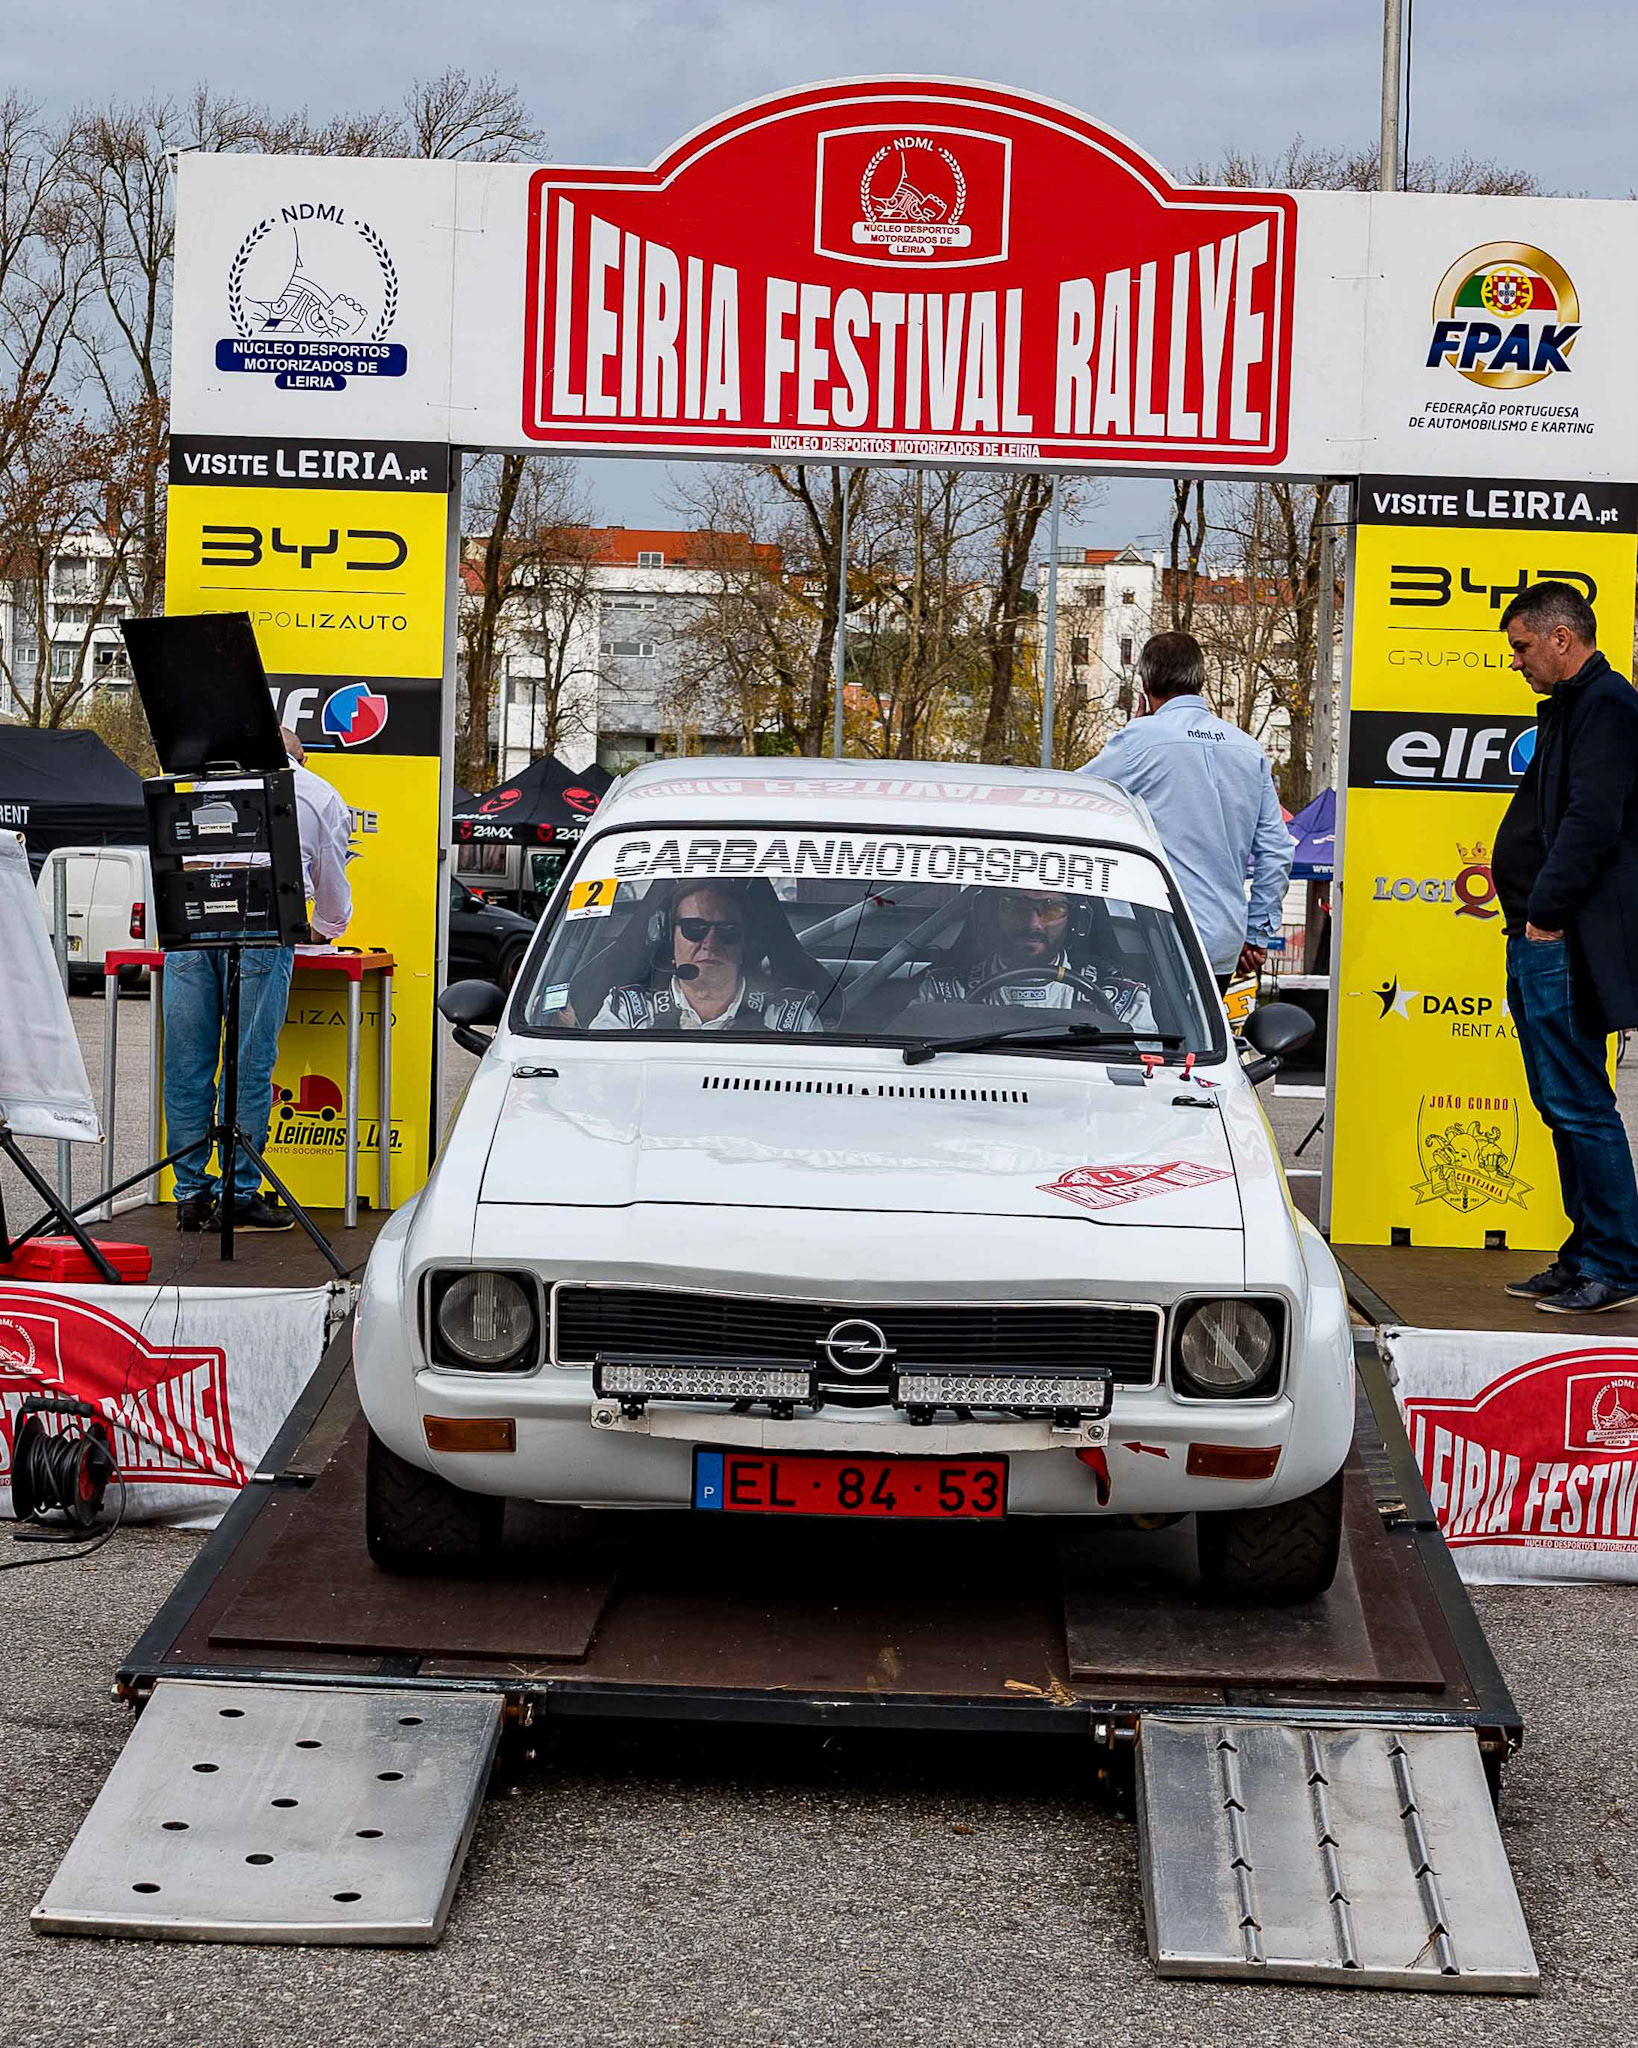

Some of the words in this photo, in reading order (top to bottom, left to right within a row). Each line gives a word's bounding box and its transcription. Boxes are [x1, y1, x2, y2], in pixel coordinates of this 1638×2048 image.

[893, 137, 934, 152] NDML
[281, 203, 345, 225] NDML
[904, 226, 960, 235] DESPORTOS
[870, 234, 937, 244] MOTORIZADOS
[940, 236, 953, 244] DE
[896, 245, 926, 254] LEIRIA
[552, 196, 741, 422] LEIRIA
[763, 277, 1033, 433] FESTIVAL
[1054, 219, 1269, 441] RALLYE
[298, 344, 390, 358] DESPORTOS
[1425, 320, 1583, 373] FPAK
[244, 358, 353, 372] MOTORIZADOS
[357, 362, 378, 373] DE
[286, 375, 335, 388] LEIRIA
[1424, 401, 1496, 417] FEDERAÇÃO
[1499, 405, 1579, 418] PORTUGUESA
[1408, 417, 1425, 428] DE
[1427, 418, 1527, 432] AUTOMOBILISMO
[1530, 421, 1538, 432] E
[1541, 422, 1595, 434] KARTING
[770, 436, 819, 450] NUCLEO
[822, 438, 892, 453] DESPORTOS
[894, 441, 980, 456] MOTORIZADOS
[983, 444, 999, 456] DE
[1001, 445, 1040, 458] LEIRIA
[183, 453, 269, 476] VISITE
[1373, 492, 1458, 516] VISITE
[201, 525, 408, 571] BYD
[1187, 729, 1226, 742] ndml.pt
[1386, 727, 1507, 780] elf
[473, 825, 514, 839] 24MX
[614, 839, 1119, 892] CARBANMOTORSPORT
[584, 881, 604, 907] 2
[1422, 996, 1492, 1015] DASP
[1451, 1022, 1492, 1037] RENT
[1495, 1025, 1506, 1038] A
[1429, 1094, 1461, 1109] JOÃO
[366, 1124, 403, 1148] La.
[292, 1147, 334, 1156] SOCORRO
[1099, 1170, 1122, 1183] 2
[1611, 1379, 1635, 1389] NDML
[98, 1361, 234, 1479] RALLYE
[703, 1486, 714, 1499] P
[1521, 1460, 1638, 1537] FESTIV
[1524, 1539, 1553, 1548] NUCLEO
[1554, 1541, 1595, 1550] DESPORTOS
[1596, 1543, 1638, 1553] MOTORIZADO
